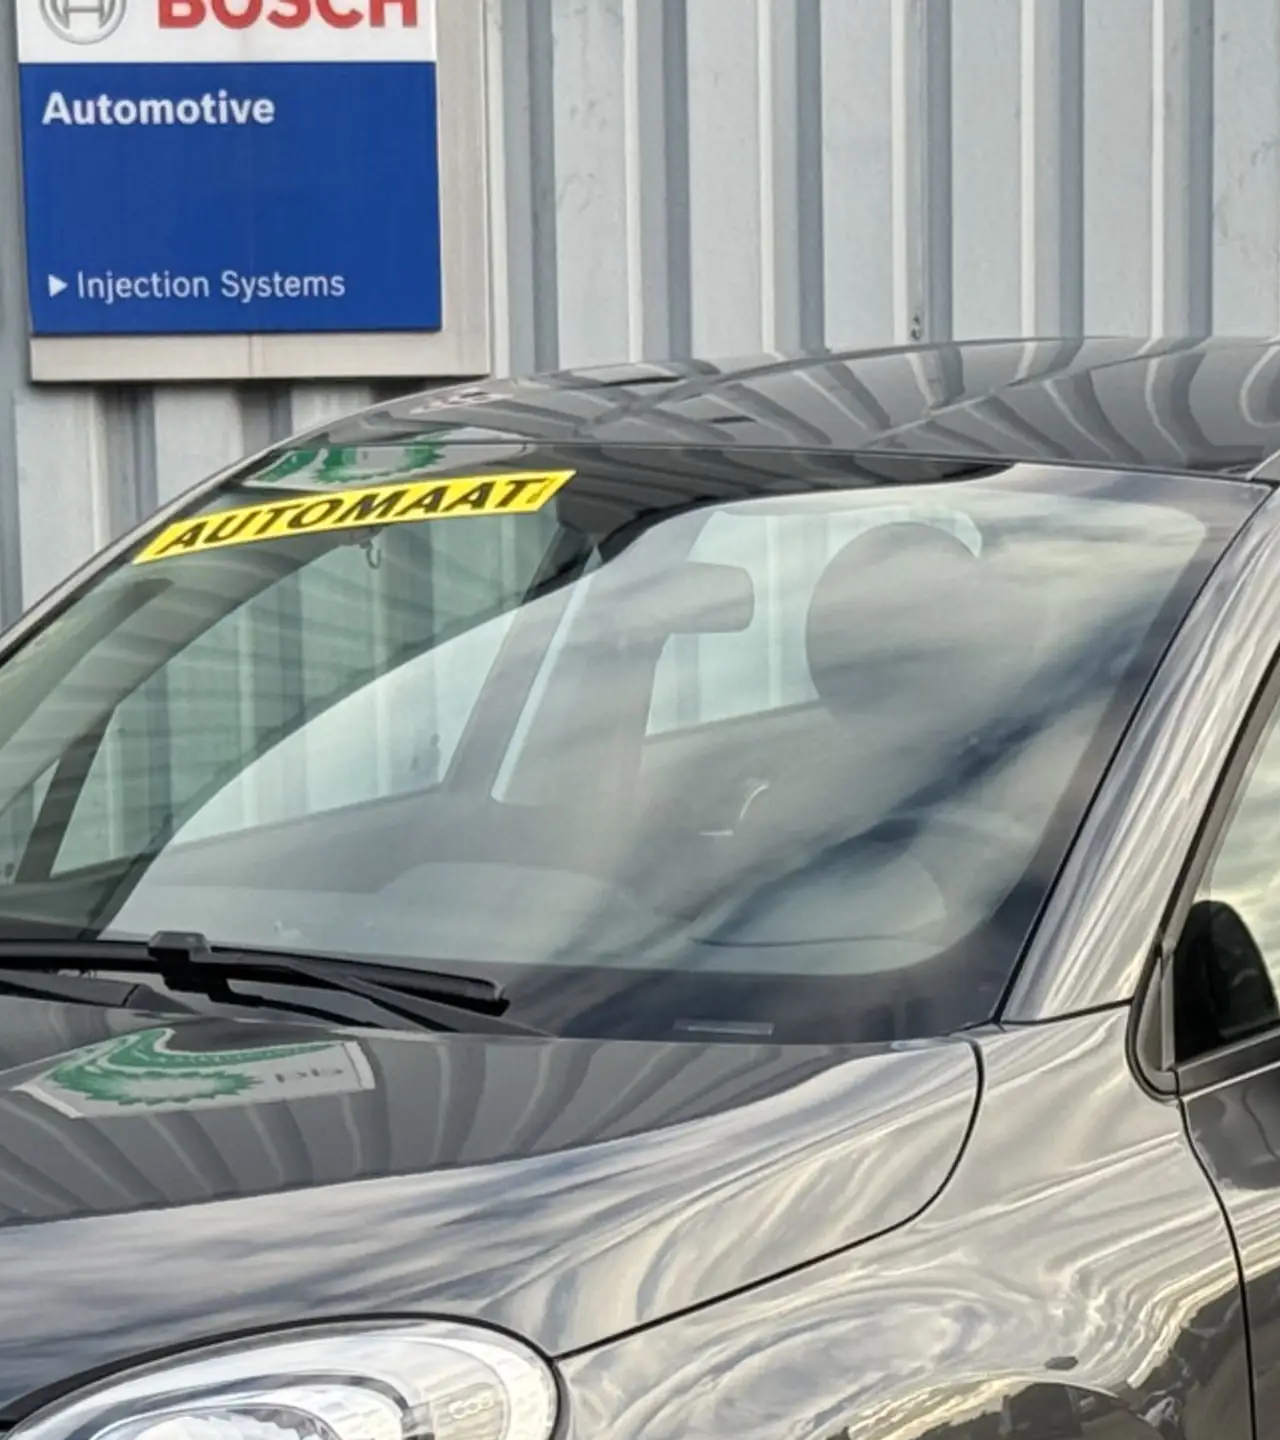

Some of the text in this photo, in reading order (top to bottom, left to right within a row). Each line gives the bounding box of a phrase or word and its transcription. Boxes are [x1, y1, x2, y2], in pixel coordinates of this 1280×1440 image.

[158, 0, 418, 29] BOSCH
[41, 89, 276, 126] Automotive
[77, 270, 346, 304] Injection Systems
